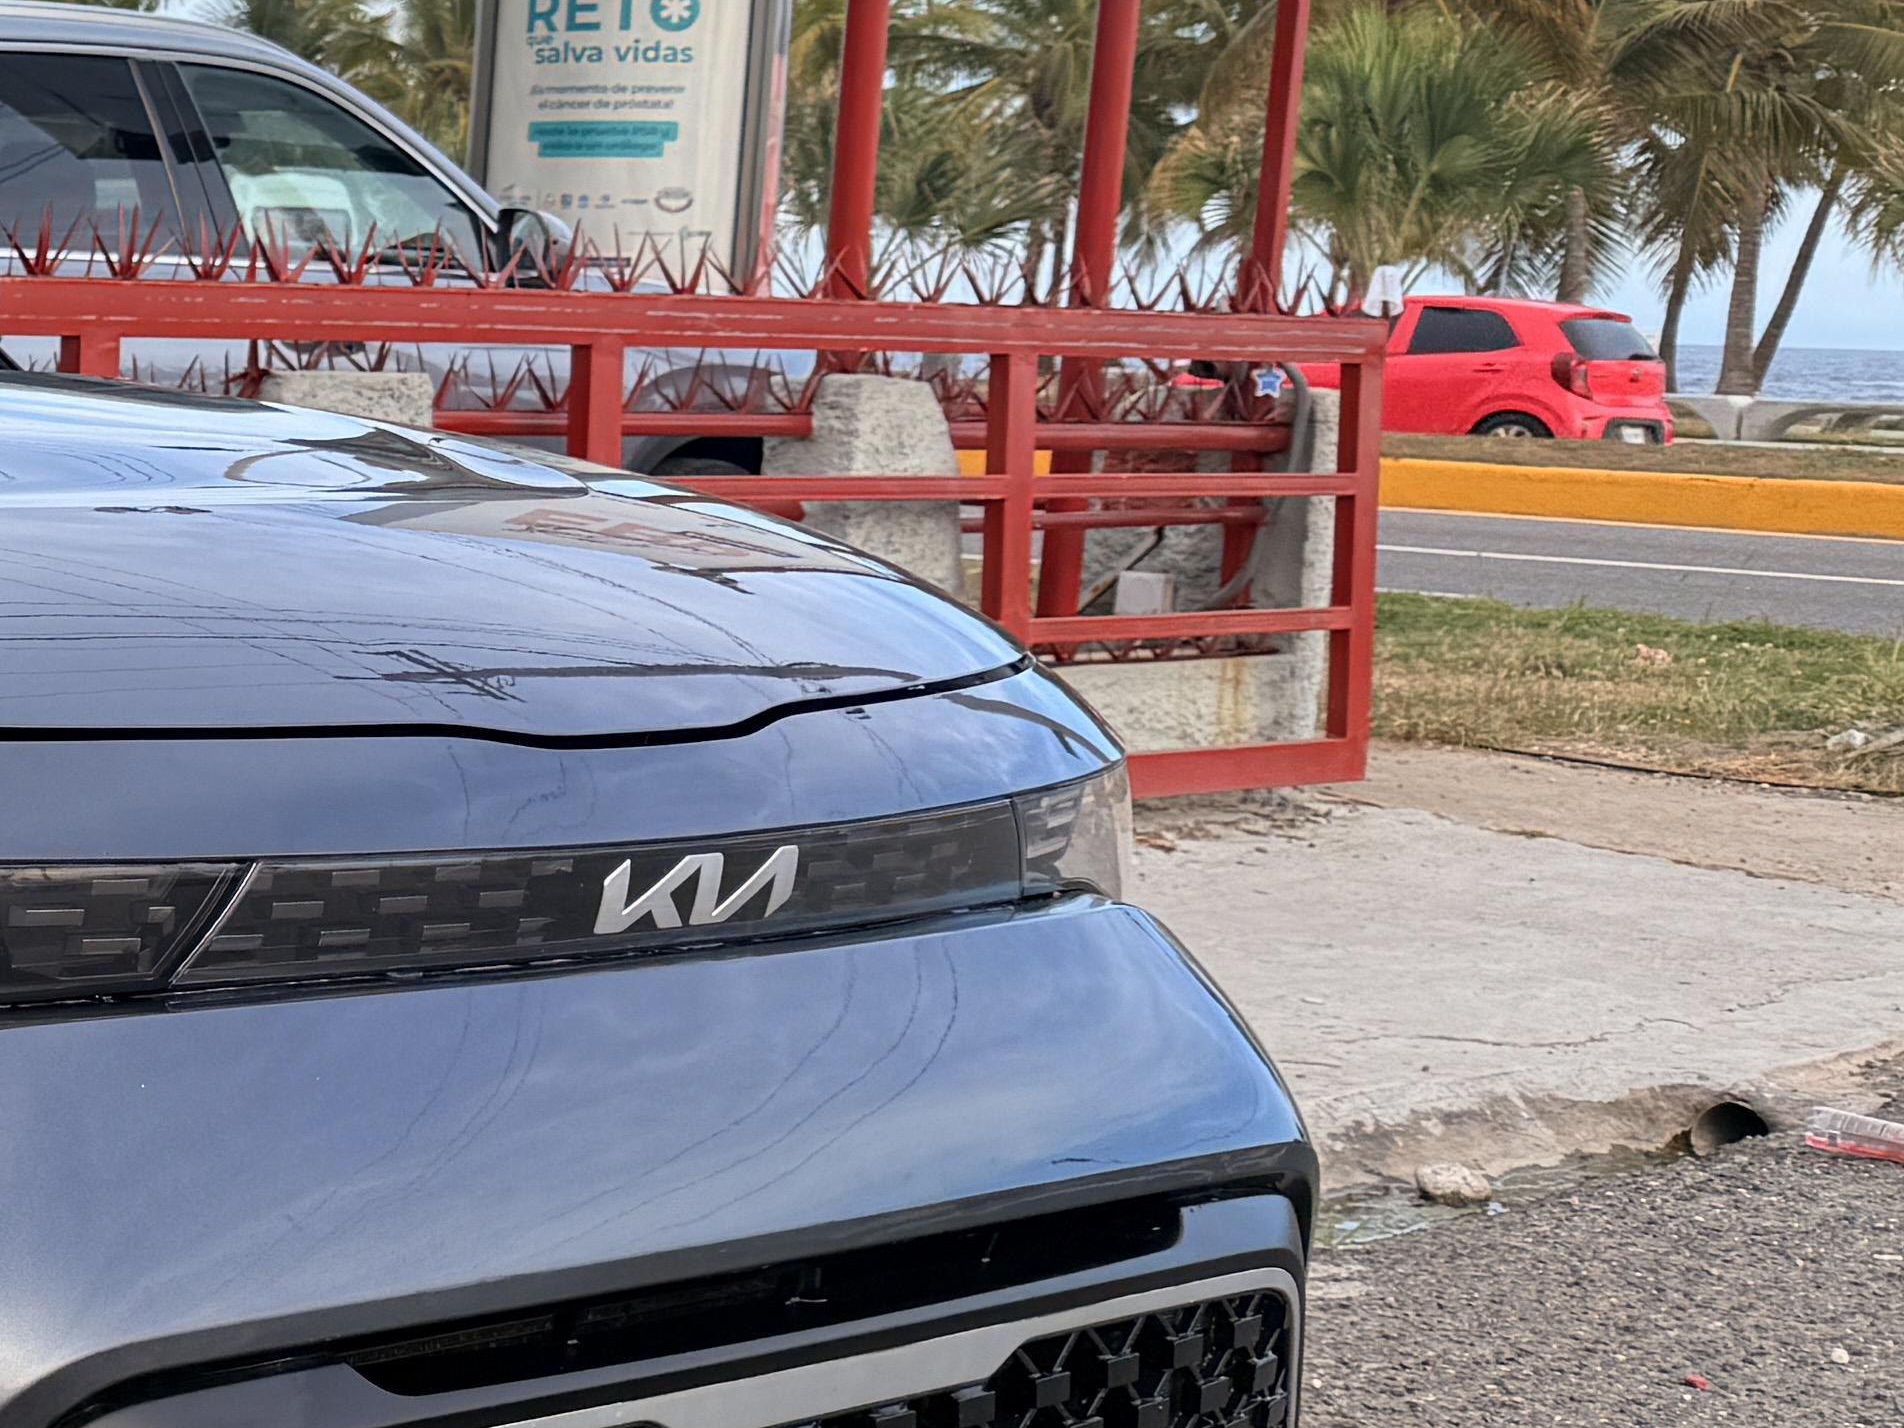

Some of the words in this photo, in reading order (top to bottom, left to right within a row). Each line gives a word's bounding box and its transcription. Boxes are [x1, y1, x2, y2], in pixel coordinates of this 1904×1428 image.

[526, 34, 555, 48] que
[535, 40, 603, 64] salva
[614, 39, 694, 63] vidas
[593, 845, 799, 934] KIA
